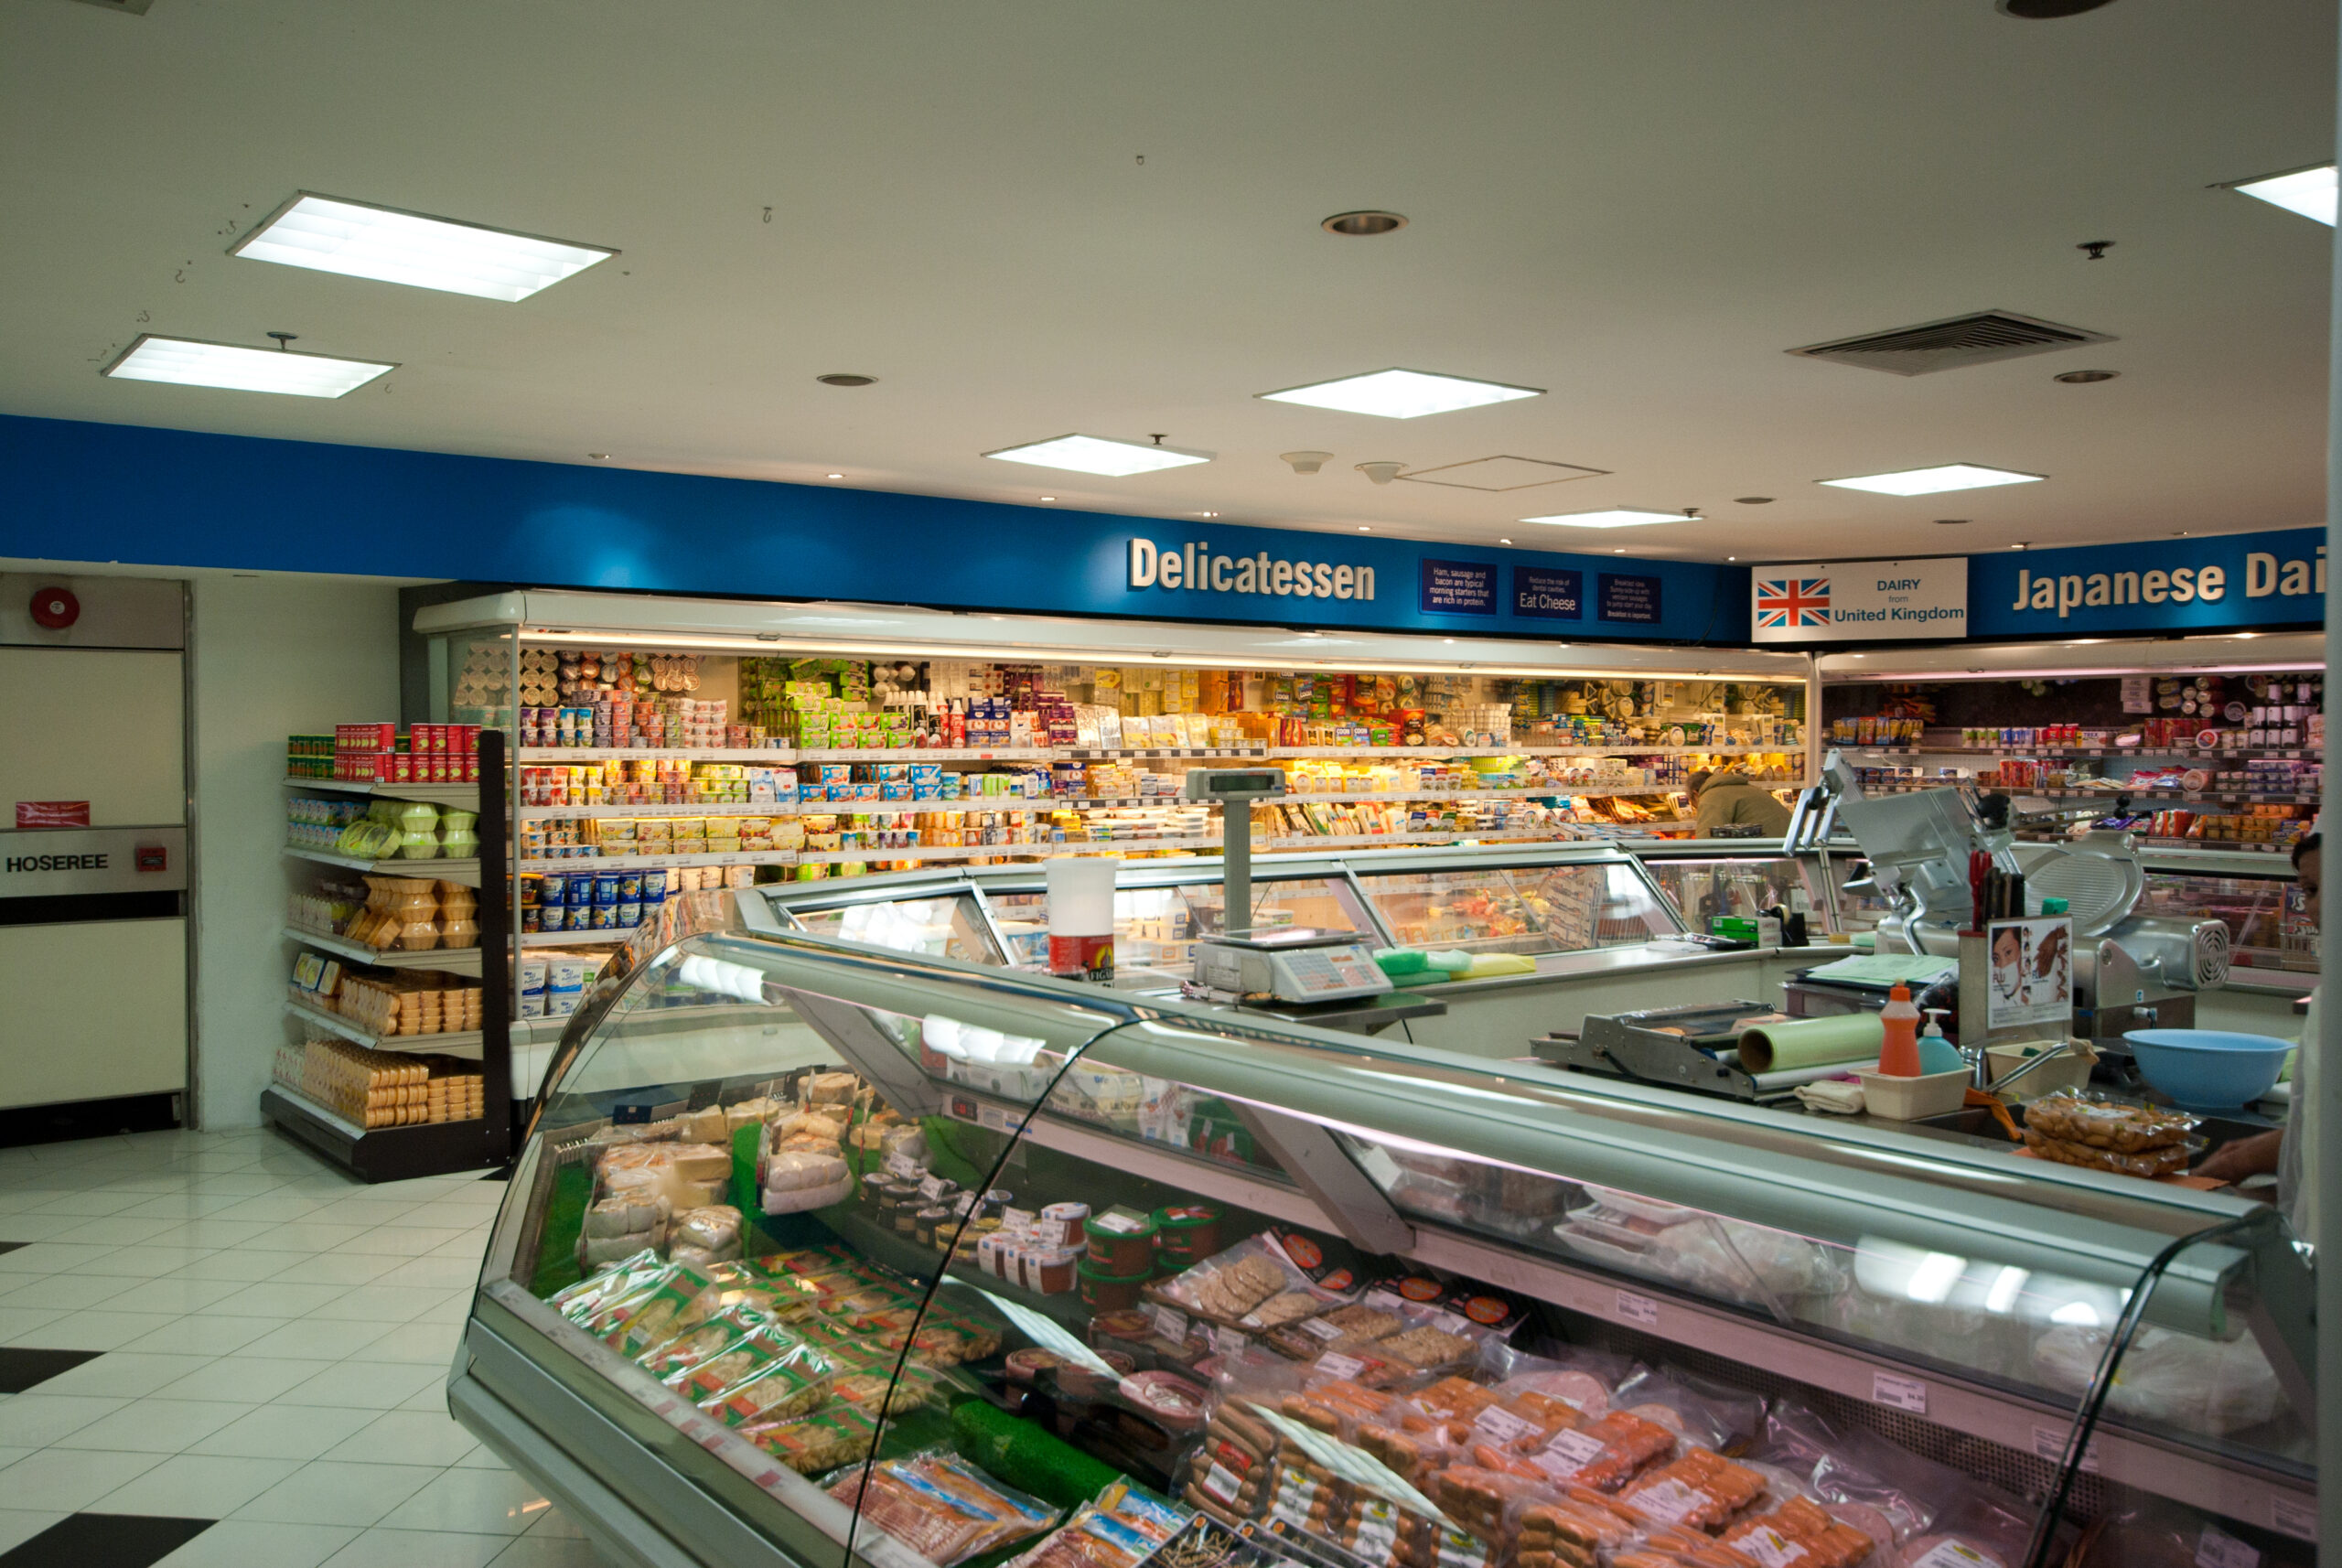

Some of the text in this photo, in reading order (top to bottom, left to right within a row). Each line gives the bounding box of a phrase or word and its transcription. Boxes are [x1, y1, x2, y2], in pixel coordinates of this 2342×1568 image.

[1128, 537, 1375, 601] Delicatessen
[1434, 567, 1486, 579] Ham, sausage and
[1434, 576, 1453, 585] bacon
[1465, 578, 1484, 588] typical
[1877, 579, 1921, 591] DAIRY
[1429, 586, 1489, 597] morning starters that
[2012, 564, 2226, 618] Japanese
[1433, 596, 1486, 607] are rich in protein.
[1520, 592, 1576, 611] Eat Cheese
[1888, 595, 1908, 604] from
[1835, 607, 1964, 623] United Kingdom
[7, 854, 109, 873] HOSEREE
